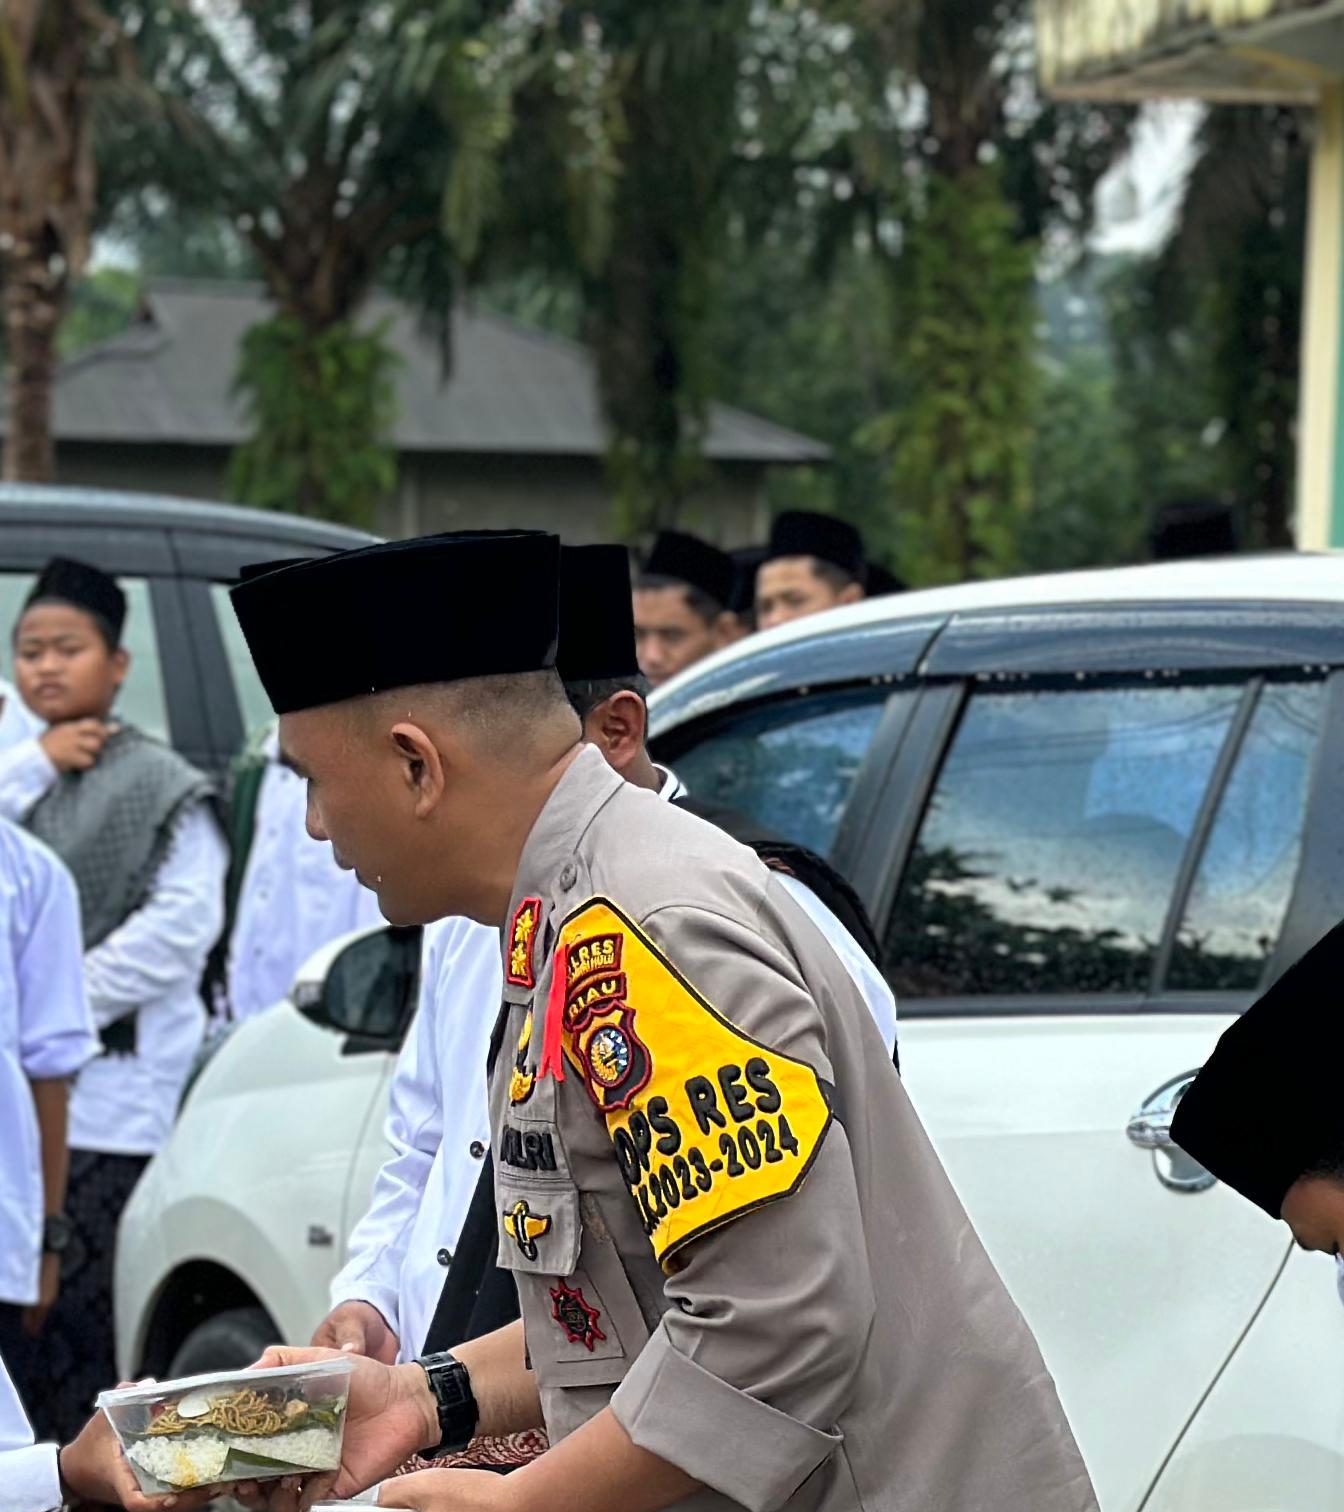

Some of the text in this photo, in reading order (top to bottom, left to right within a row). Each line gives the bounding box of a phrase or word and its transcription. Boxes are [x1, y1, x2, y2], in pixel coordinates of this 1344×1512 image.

[569, 939, 614, 970] LRES
[569, 979, 616, 1018] RIAU
[613, 1057, 781, 1186] OPS RES
